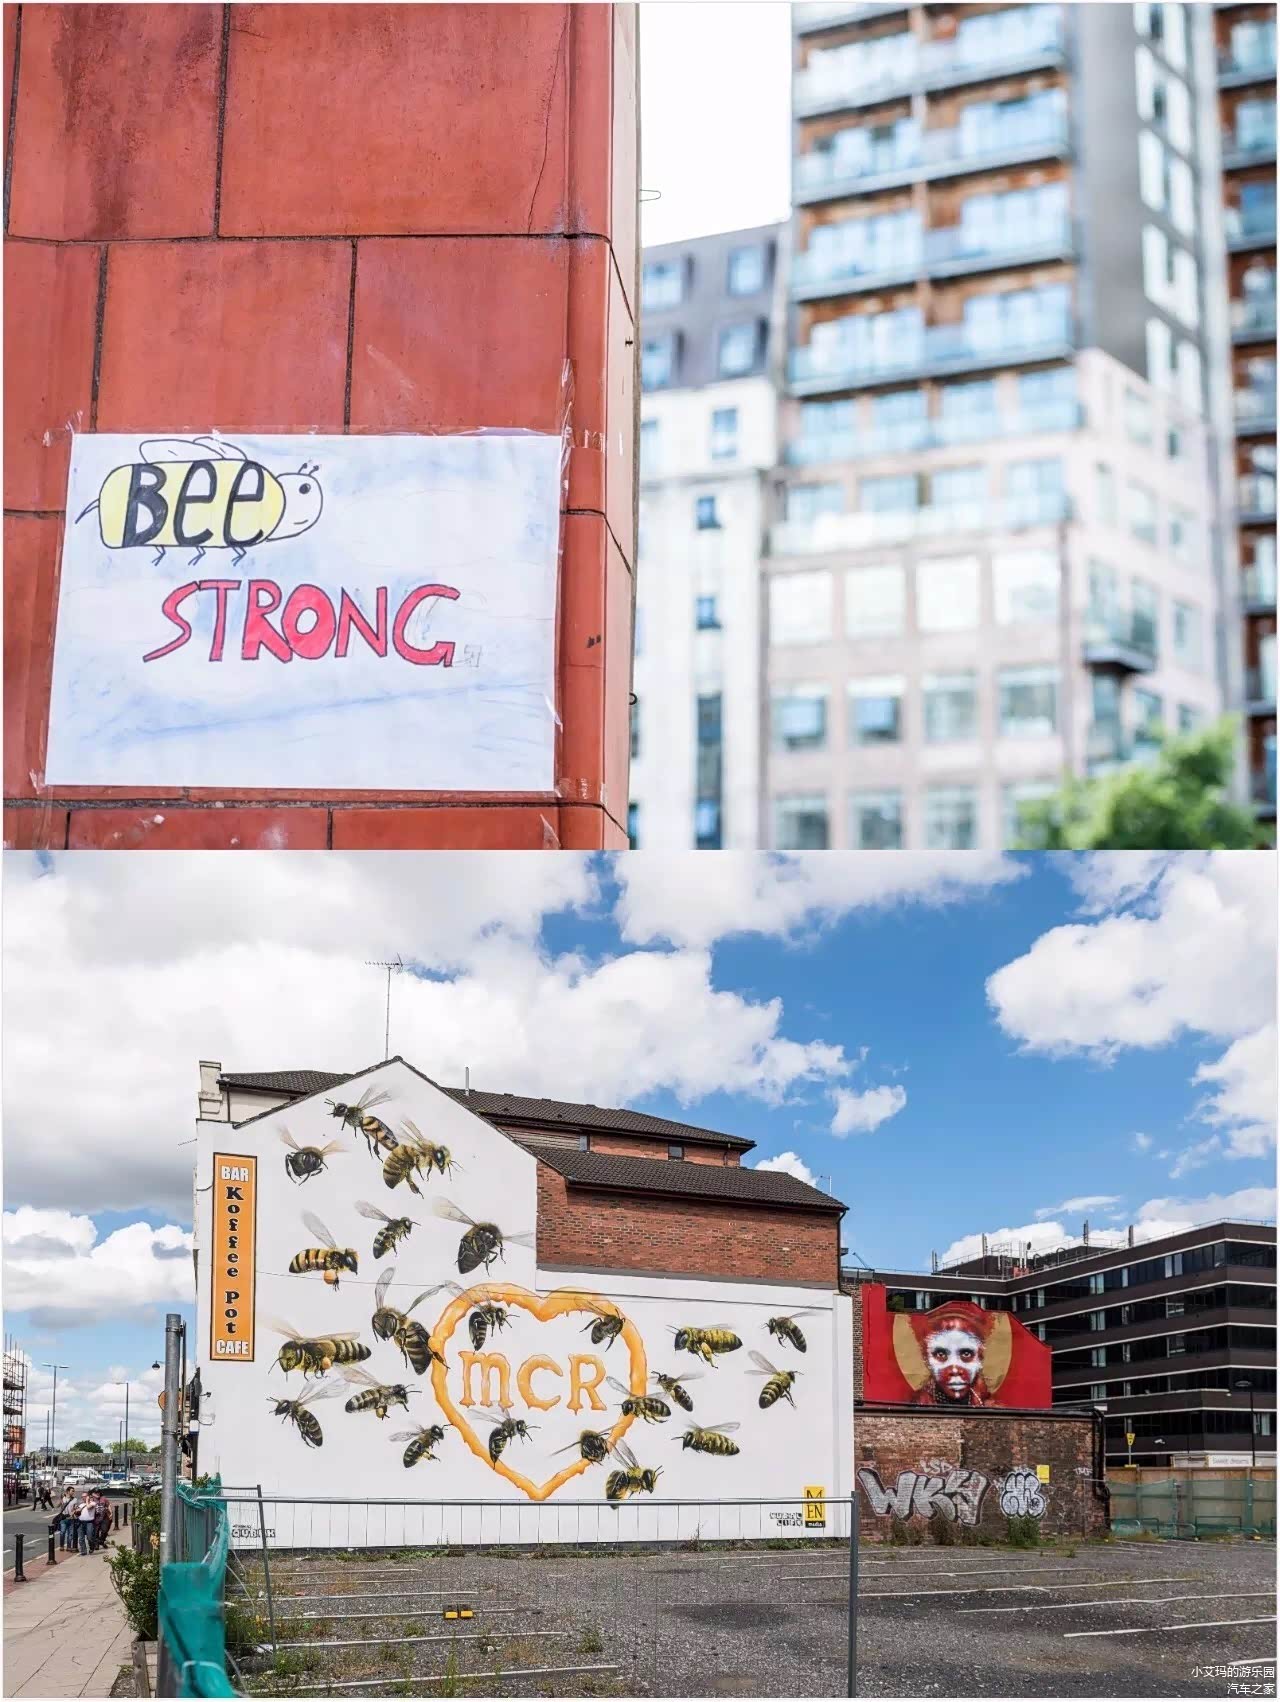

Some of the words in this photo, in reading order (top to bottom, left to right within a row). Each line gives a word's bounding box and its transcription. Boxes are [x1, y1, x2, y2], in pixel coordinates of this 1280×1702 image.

[143, 579, 460, 667] STRONG
[220, 1165, 249, 1182] BAR
[225, 1186, 244, 1278] Koffee
[216, 1339, 249, 1355] CAFE
